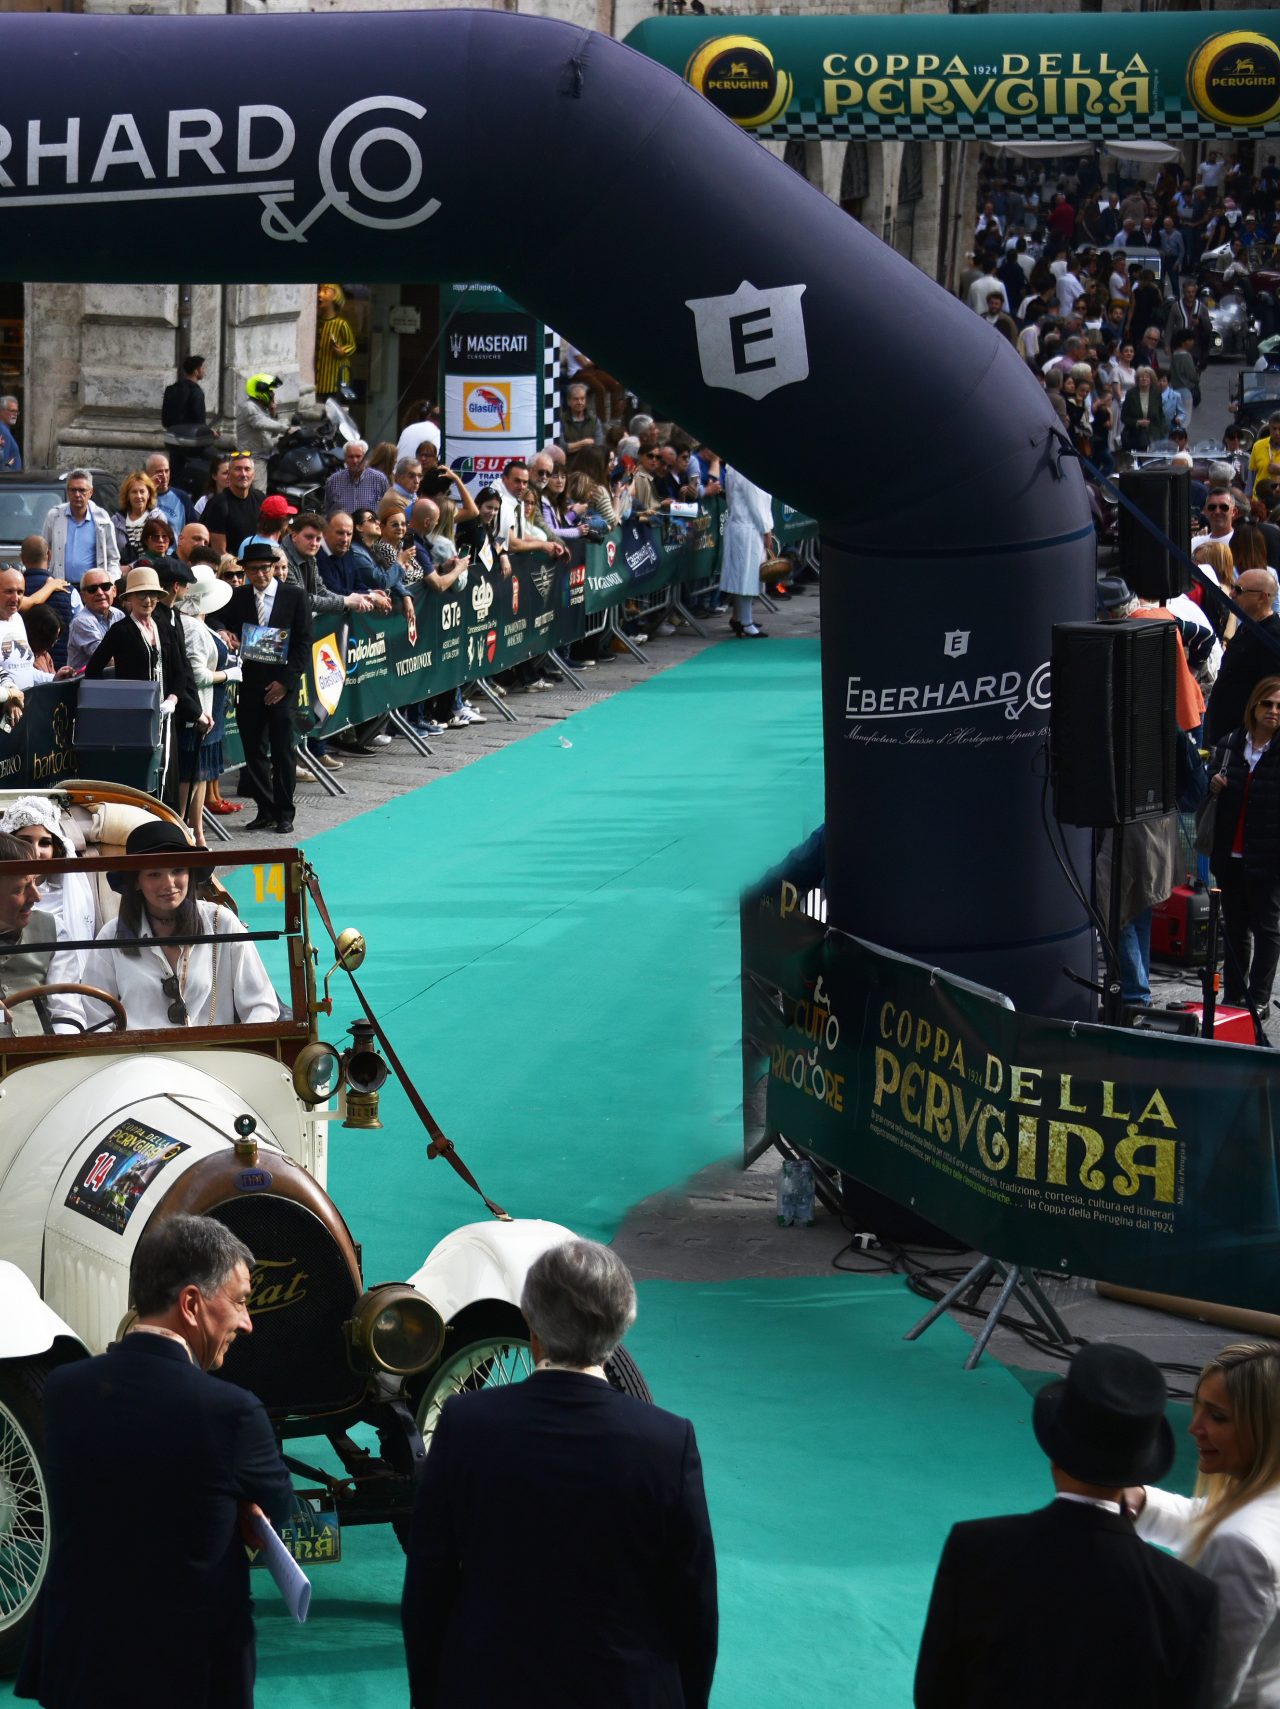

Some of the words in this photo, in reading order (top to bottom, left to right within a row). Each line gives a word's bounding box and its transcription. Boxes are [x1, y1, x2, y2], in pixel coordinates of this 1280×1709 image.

[823, 53, 969, 76] COPPA
[973, 65, 997, 75] 1924
[1002, 52, 1150, 76] DELLA
[467, 335, 528, 352] MASERATI
[395, 651, 433, 678] VICTORINOX
[846, 671, 1021, 712] EBERHARD
[844, 725, 898, 746] Manufacture
[899, 728, 934, 745] Suisse
[1006, 729, 1036, 745] depuis
[252, 863, 285, 903] 14
[772, 1043, 846, 1113] RICOLORE
[880, 1001, 967, 1079] COPPA
[968, 1067, 983, 1087] 1924
[984, 1052, 1179, 1130] DELLA
[121, 1122, 146, 1138] COPPA
[83, 1152, 116, 1192] 14
[1000, 1180, 1043, 1200] tradizione,
[1045, 1190, 1085, 1206] cortesia,
[1088, 1198, 1121, 1211] cultura
[1123, 1203, 1135, 1214] ed
[1137, 1207, 1174, 1221] itinerari
[1028, 1199, 1036, 1210] la
[1038, 1202, 1066, 1216] Coppa
[1068, 1206, 1091, 1219] della
[1094, 1211, 1133, 1227] Perugina
[1136, 1218, 1150, 1229] dal
[1154, 1221, 1174, 1234] 1924
[281, 1525, 332, 1539] ELLA
